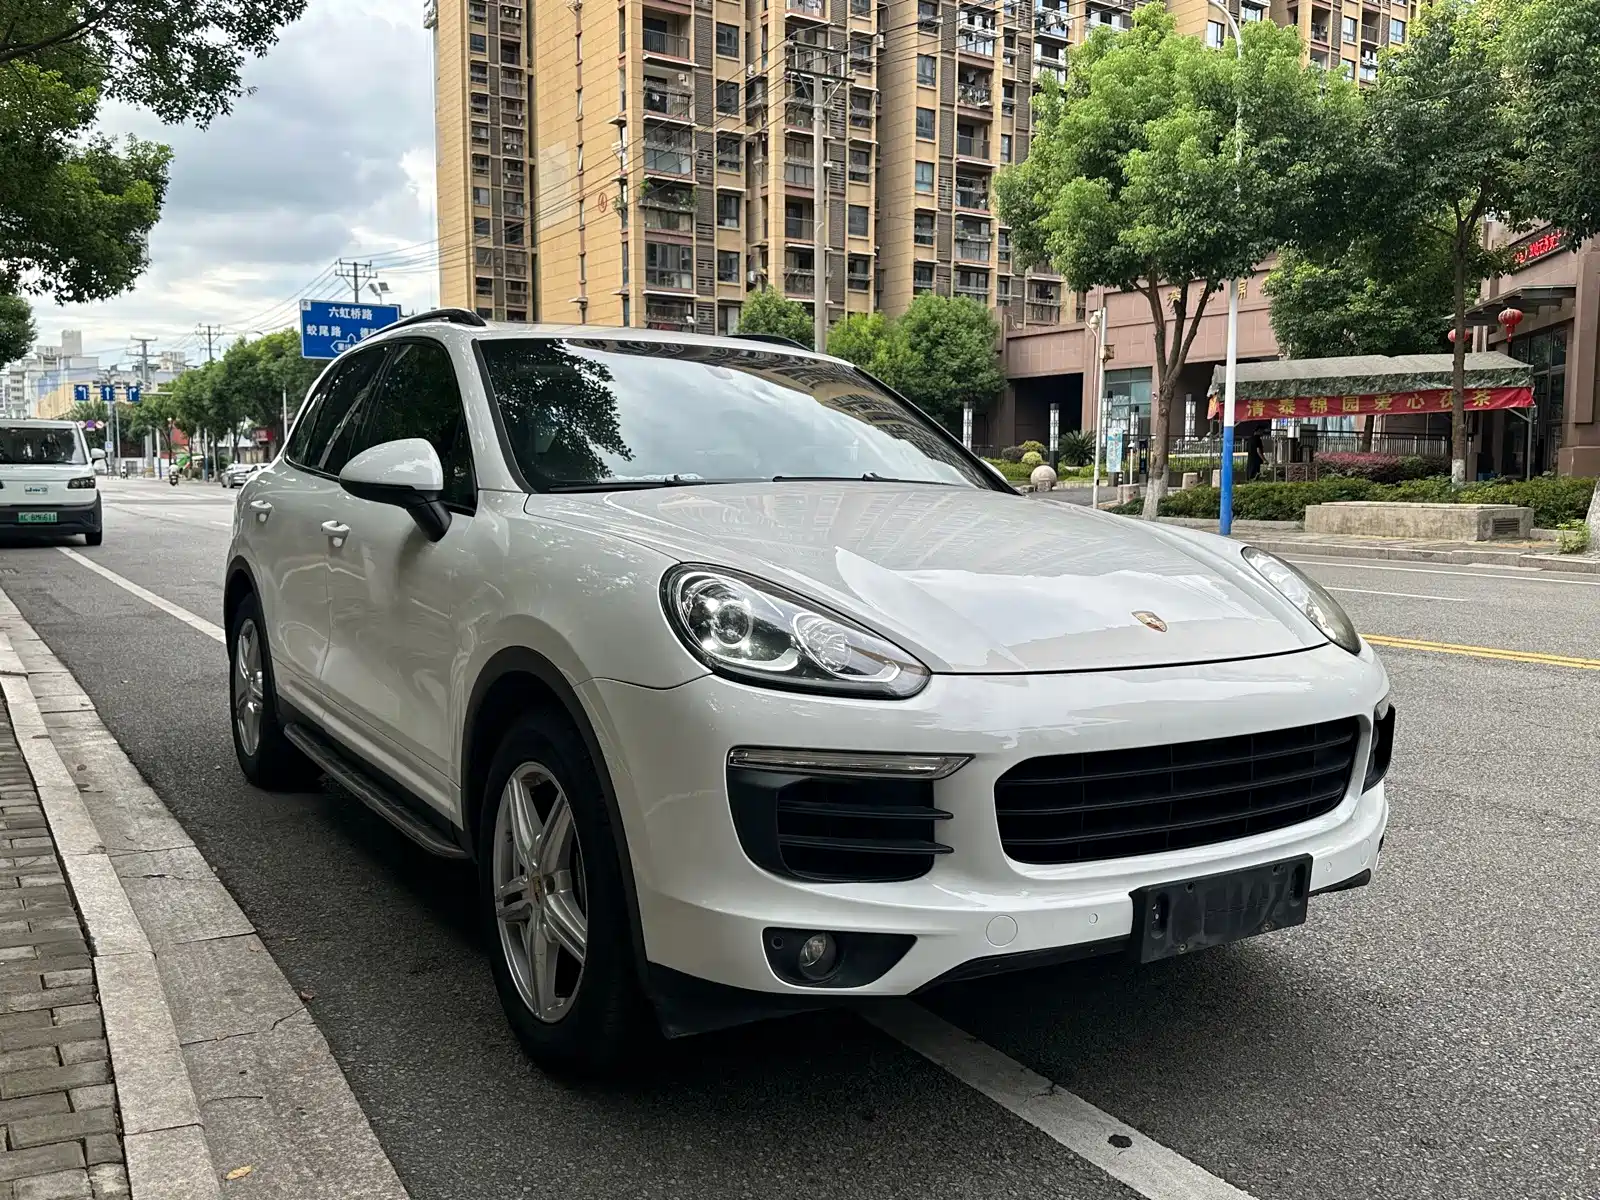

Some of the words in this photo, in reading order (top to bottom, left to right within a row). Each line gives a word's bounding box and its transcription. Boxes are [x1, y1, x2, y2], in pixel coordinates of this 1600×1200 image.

[328, 306, 373, 321] 六虹桥路
[306, 324, 342, 338] 蛟尾路
